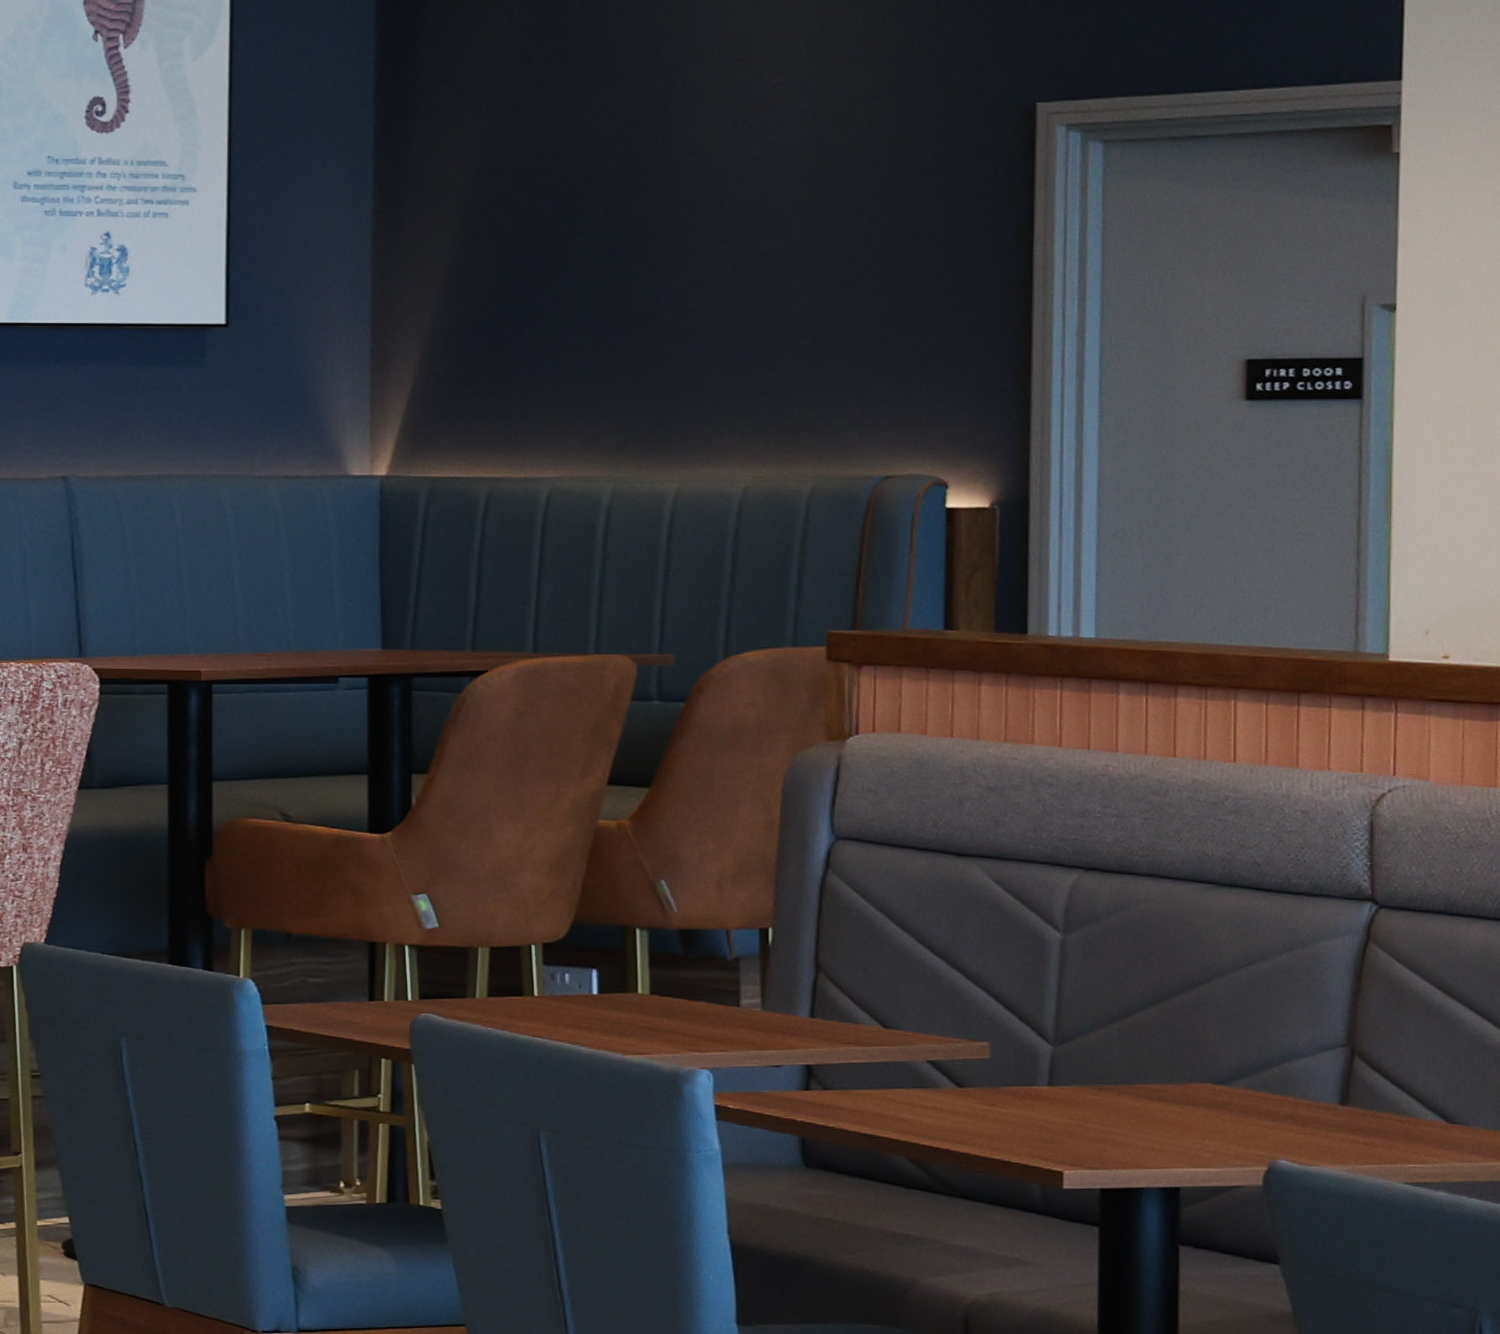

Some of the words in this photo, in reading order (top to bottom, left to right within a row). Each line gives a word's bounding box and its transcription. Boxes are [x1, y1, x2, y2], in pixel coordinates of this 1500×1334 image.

[1264, 368, 1296, 377] FIRE
[1302, 367, 1343, 377] DOOR
[1255, 381, 1291, 391] KEEP
[1296, 380, 1353, 390] CLOSED
